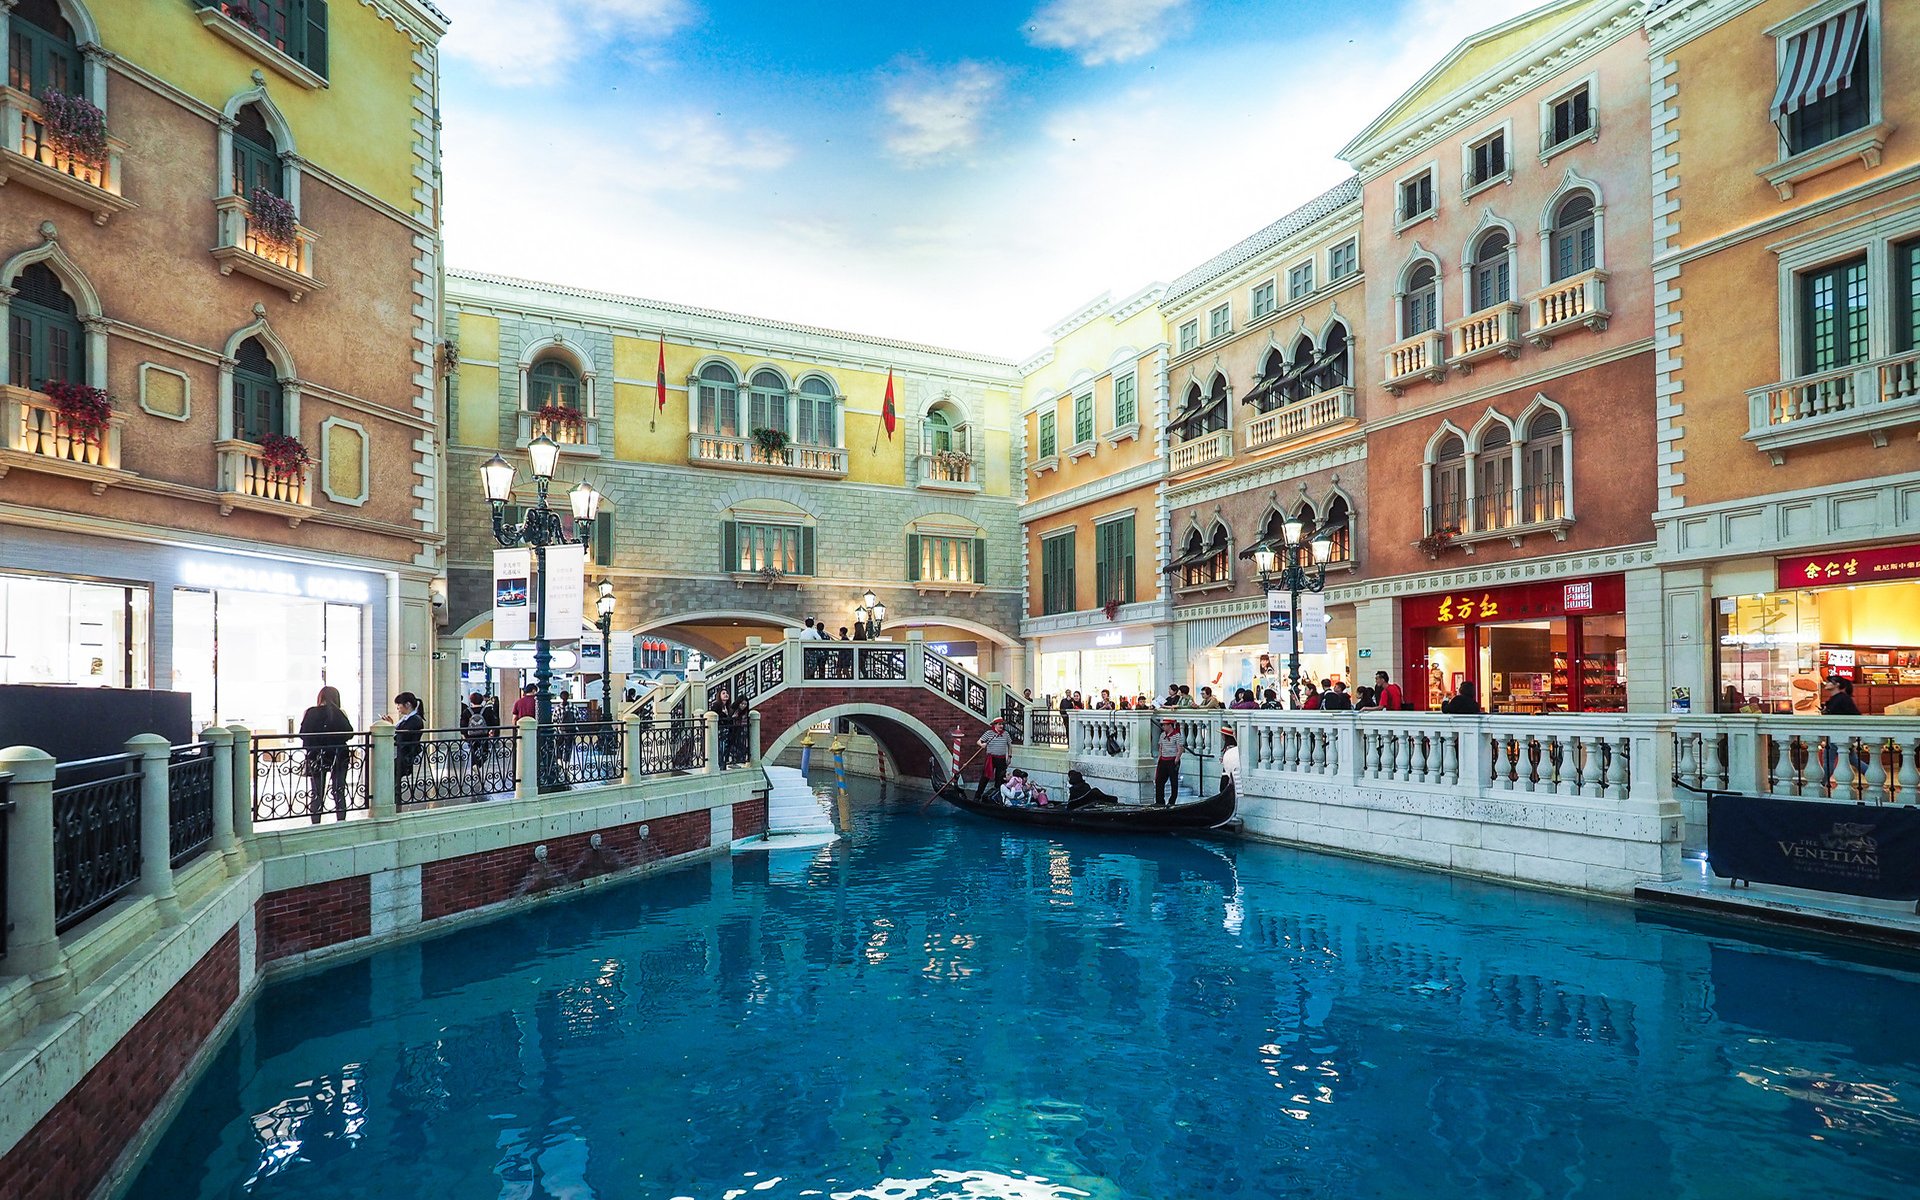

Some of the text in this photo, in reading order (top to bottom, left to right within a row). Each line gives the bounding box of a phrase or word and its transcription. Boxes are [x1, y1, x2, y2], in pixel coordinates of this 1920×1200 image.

[1804, 558, 1859, 580] 余仁生
[1437, 593, 1498, 622] 东方红
[1778, 841, 1879, 865] VENETIAN
